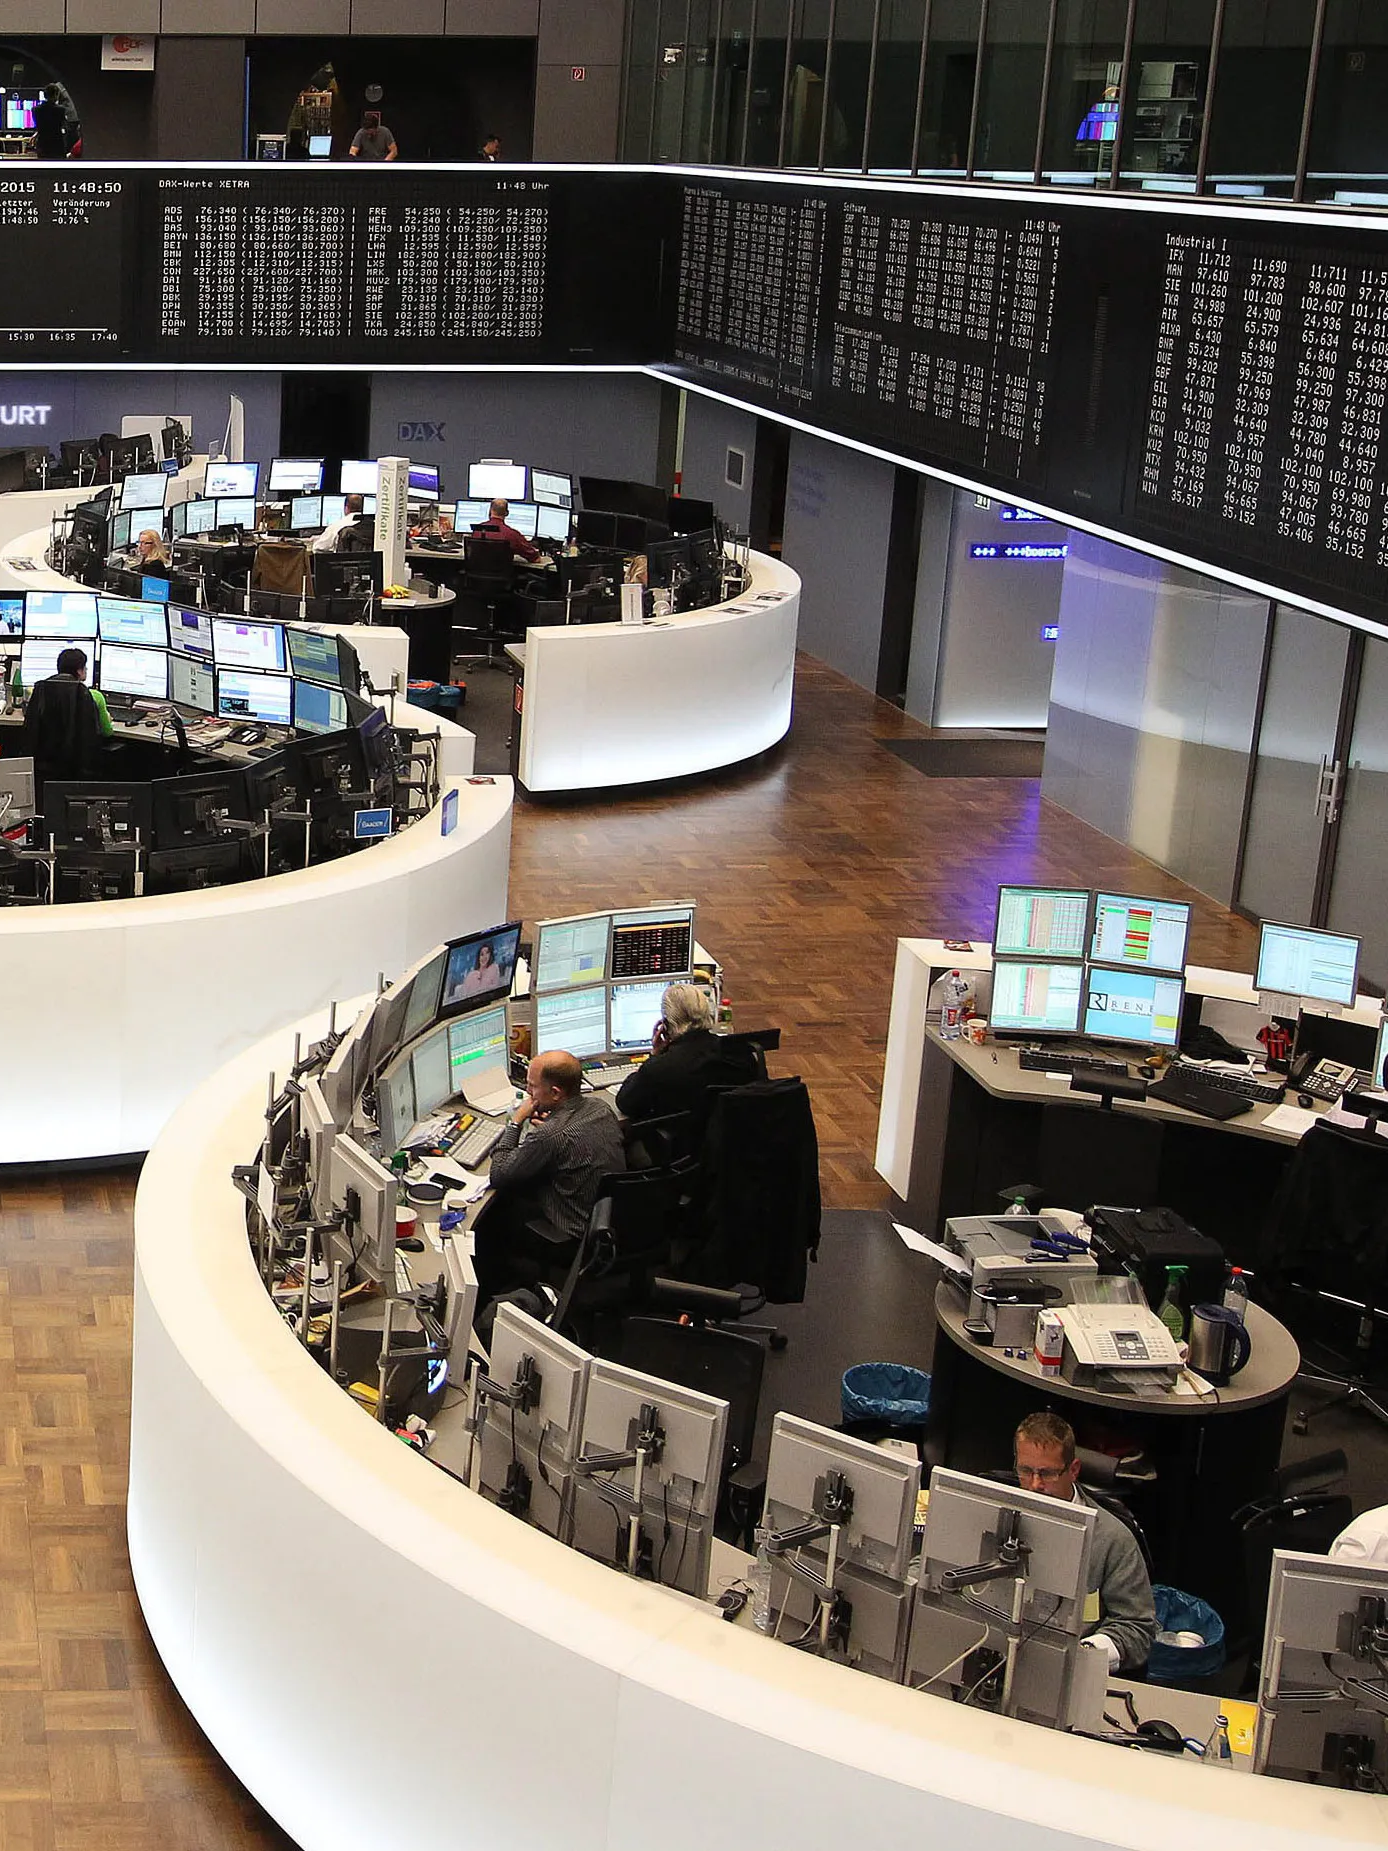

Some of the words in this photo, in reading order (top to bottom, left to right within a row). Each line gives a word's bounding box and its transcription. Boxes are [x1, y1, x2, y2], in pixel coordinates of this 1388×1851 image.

[54, 183, 121, 193] 11:48:50
[53, 199, 110, 209] Veränderung
[844, 202, 866, 213] Software
[1025, 220, 1044, 231] 11:48
[1049, 222, 1060, 232] Uhr
[1166, 234, 1215, 249] Industrial
[1222, 239, 1226, 250] I
[1170, 249, 1184, 261] IFX
[1200, 253, 1230, 267] 11,712
[1253, 258, 1286, 273] 11,690
[1167, 264, 1182, 276] MAN
[1198, 267, 1229, 282] 97,610
[1251, 274, 1285, 289] 97,783
[1166, 278, 1180, 291] SIE
[1191, 282, 1227, 297] 101,260
[1244, 289, 1283, 305] 101,200
[1165, 293, 1179, 305] TKA
[1194, 298, 1225, 313] 24,988
[1247, 305, 1280, 321] 24,900
[9, 332, 34, 340] 15:30
[51, 332, 75, 340] 16:35
[93, 332, 117, 340] 17:40
[834, 323, 882, 341] Telecommunication
[1162, 308, 1177, 320] AIR
[1192, 313, 1223, 328] 65,657
[1245, 321, 1279, 337] 65,579
[1161, 322, 1180, 336] AIXA
[1196, 329, 1221, 343] 6,430
[1249, 338, 1276, 353] 6,840
[1159, 337, 1173, 349] BNR
[1189, 342, 1219, 358] 55,234
[1241, 352, 1274, 369] 55,398
[1187, 357, 1217, 373] 99,202
[1240, 367, 1272, 384] 99,250
[1186, 373, 1214, 388] 47,871
[1238, 383, 1270, 400] 47,969
[1184, 387, 1214, 403] 31,900
[1236, 398, 1269, 416] 32,309
[1150, 410, 1165, 422] KCO
[1186, 418, 1210, 433] 9,032
[1237, 430, 1265, 447] 8,957
[1182, 403, 1212, 418] 44,710
[1234, 414, 1267, 431] 44,640
[399, 421, 446, 442] DAX
[1149, 424, 1164, 437] KRN
[1174, 430, 1209, 448] 102,100
[1225, 443, 1263, 463] 102,100
[1146, 452, 1160, 466] MTX
[1175, 461, 1205, 478] 94,432
[1227, 475, 1259, 493] 94,067
[1177, 446, 1207, 463] 70,950
[1229, 459, 1261, 478] 70,950
[1144, 467, 1159, 480] RHM
[1173, 476, 1203, 493] 47,169
[1224, 491, 1257, 509] 46,665
[1143, 481, 1157, 495] WIN
[1172, 490, 1202, 508] 35,517
[1223, 506, 1255, 525] 35,152
